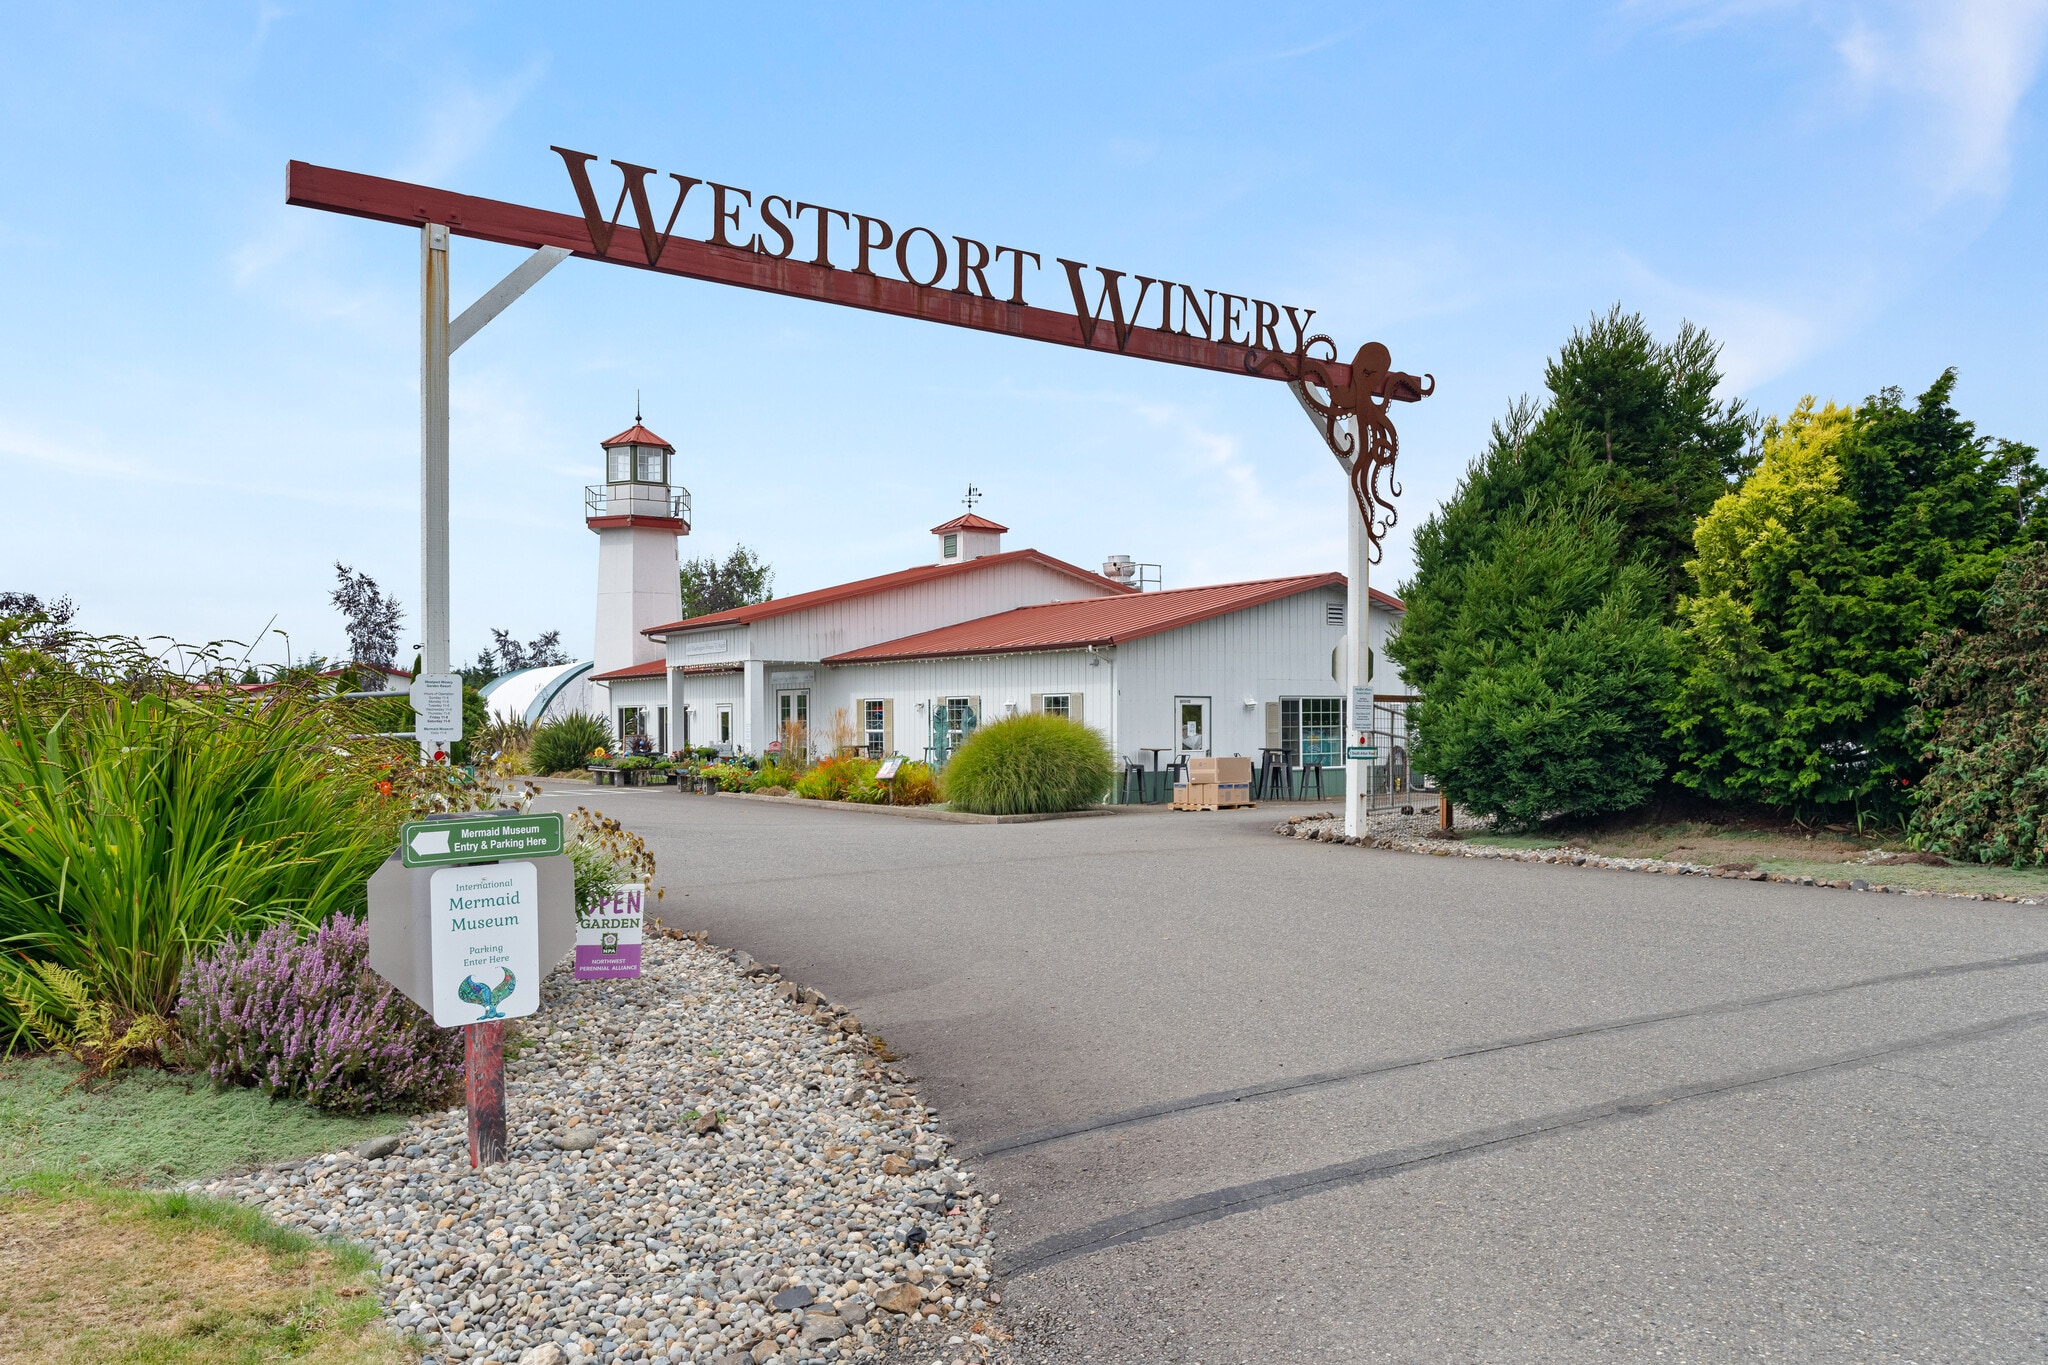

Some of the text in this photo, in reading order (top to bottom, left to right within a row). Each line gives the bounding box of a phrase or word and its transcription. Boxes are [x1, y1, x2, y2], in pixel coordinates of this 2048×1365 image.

[550, 145, 1317, 357] WESTPORT WINERY
[461, 825, 540, 838] Mermaid Museum
[454, 836, 547, 853] Entry & Parking Here
[456, 878, 513, 892] International
[449, 890, 521, 911] Mermaid
[451, 915, 520, 932] Museum
[580, 918, 641, 929] GARDEN
[469, 944, 504, 955] Parking
[463, 955, 510, 967] Enter Here
